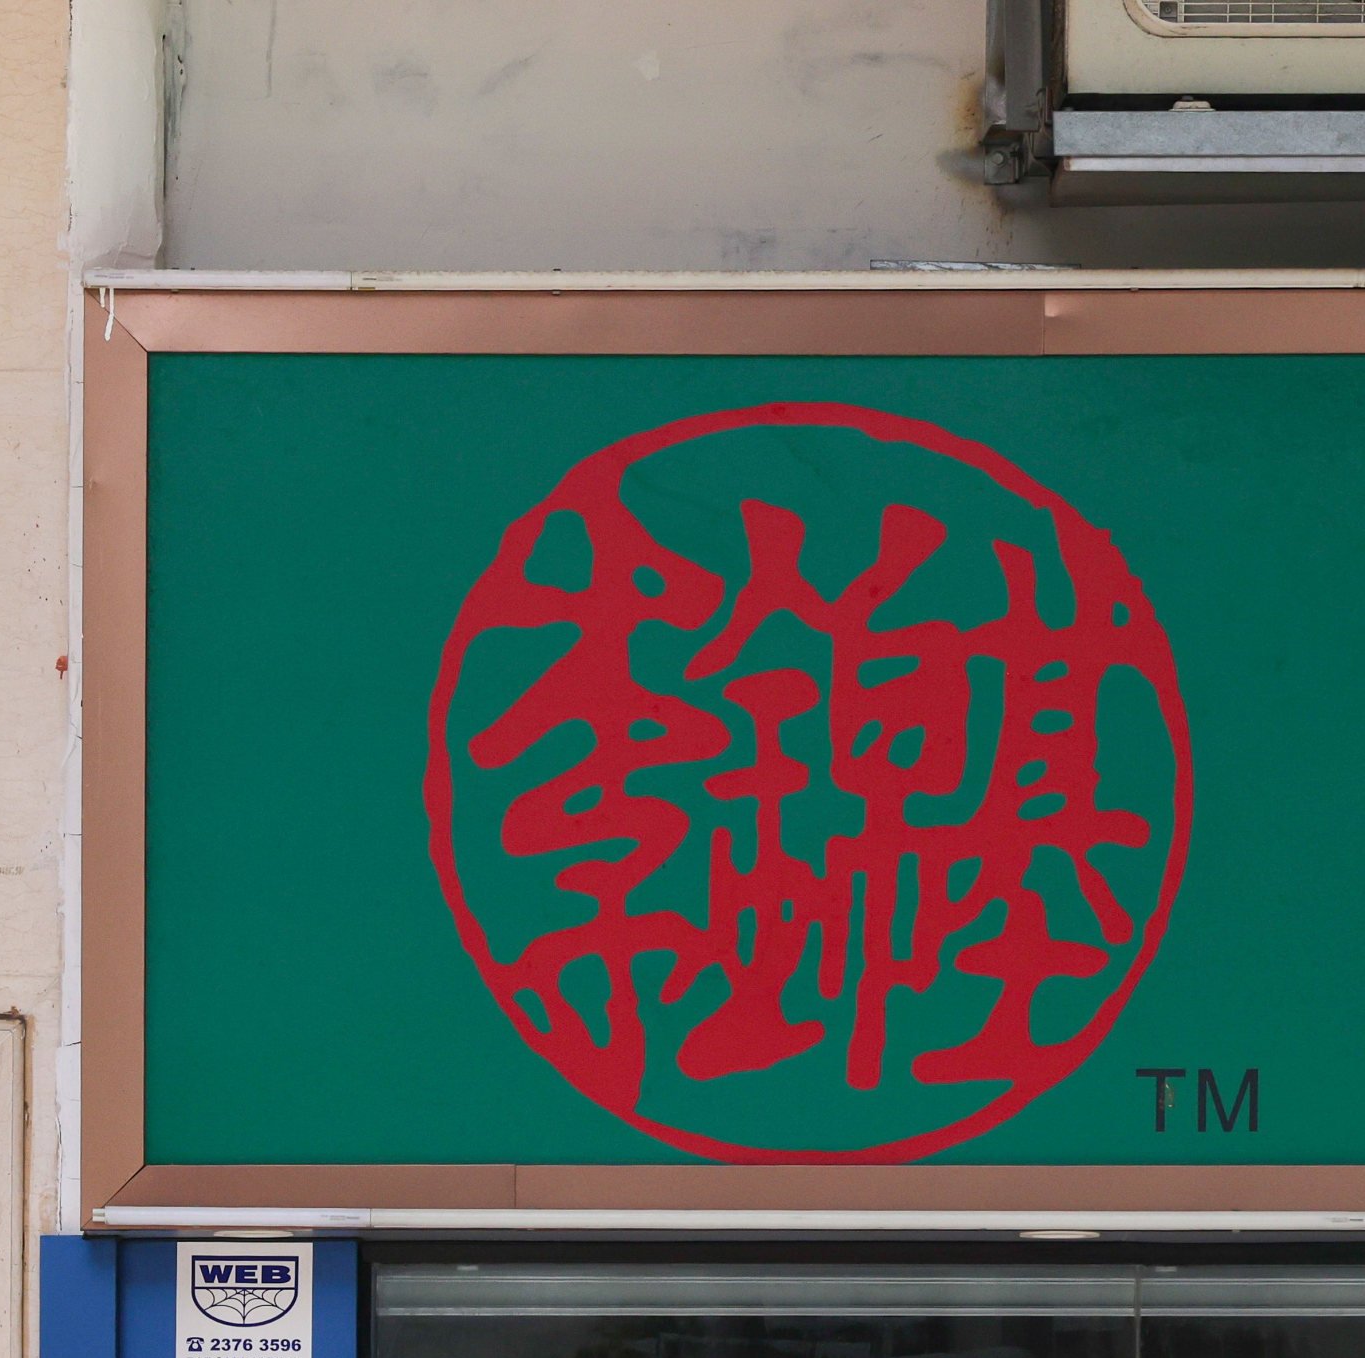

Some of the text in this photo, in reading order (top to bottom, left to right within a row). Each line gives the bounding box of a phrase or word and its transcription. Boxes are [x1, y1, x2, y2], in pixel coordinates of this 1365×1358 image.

[1136, 1067, 1260, 1134] TM
[199, 1264, 292, 1285] WEB
[210, 1338, 302, 1352] 2376 3596
